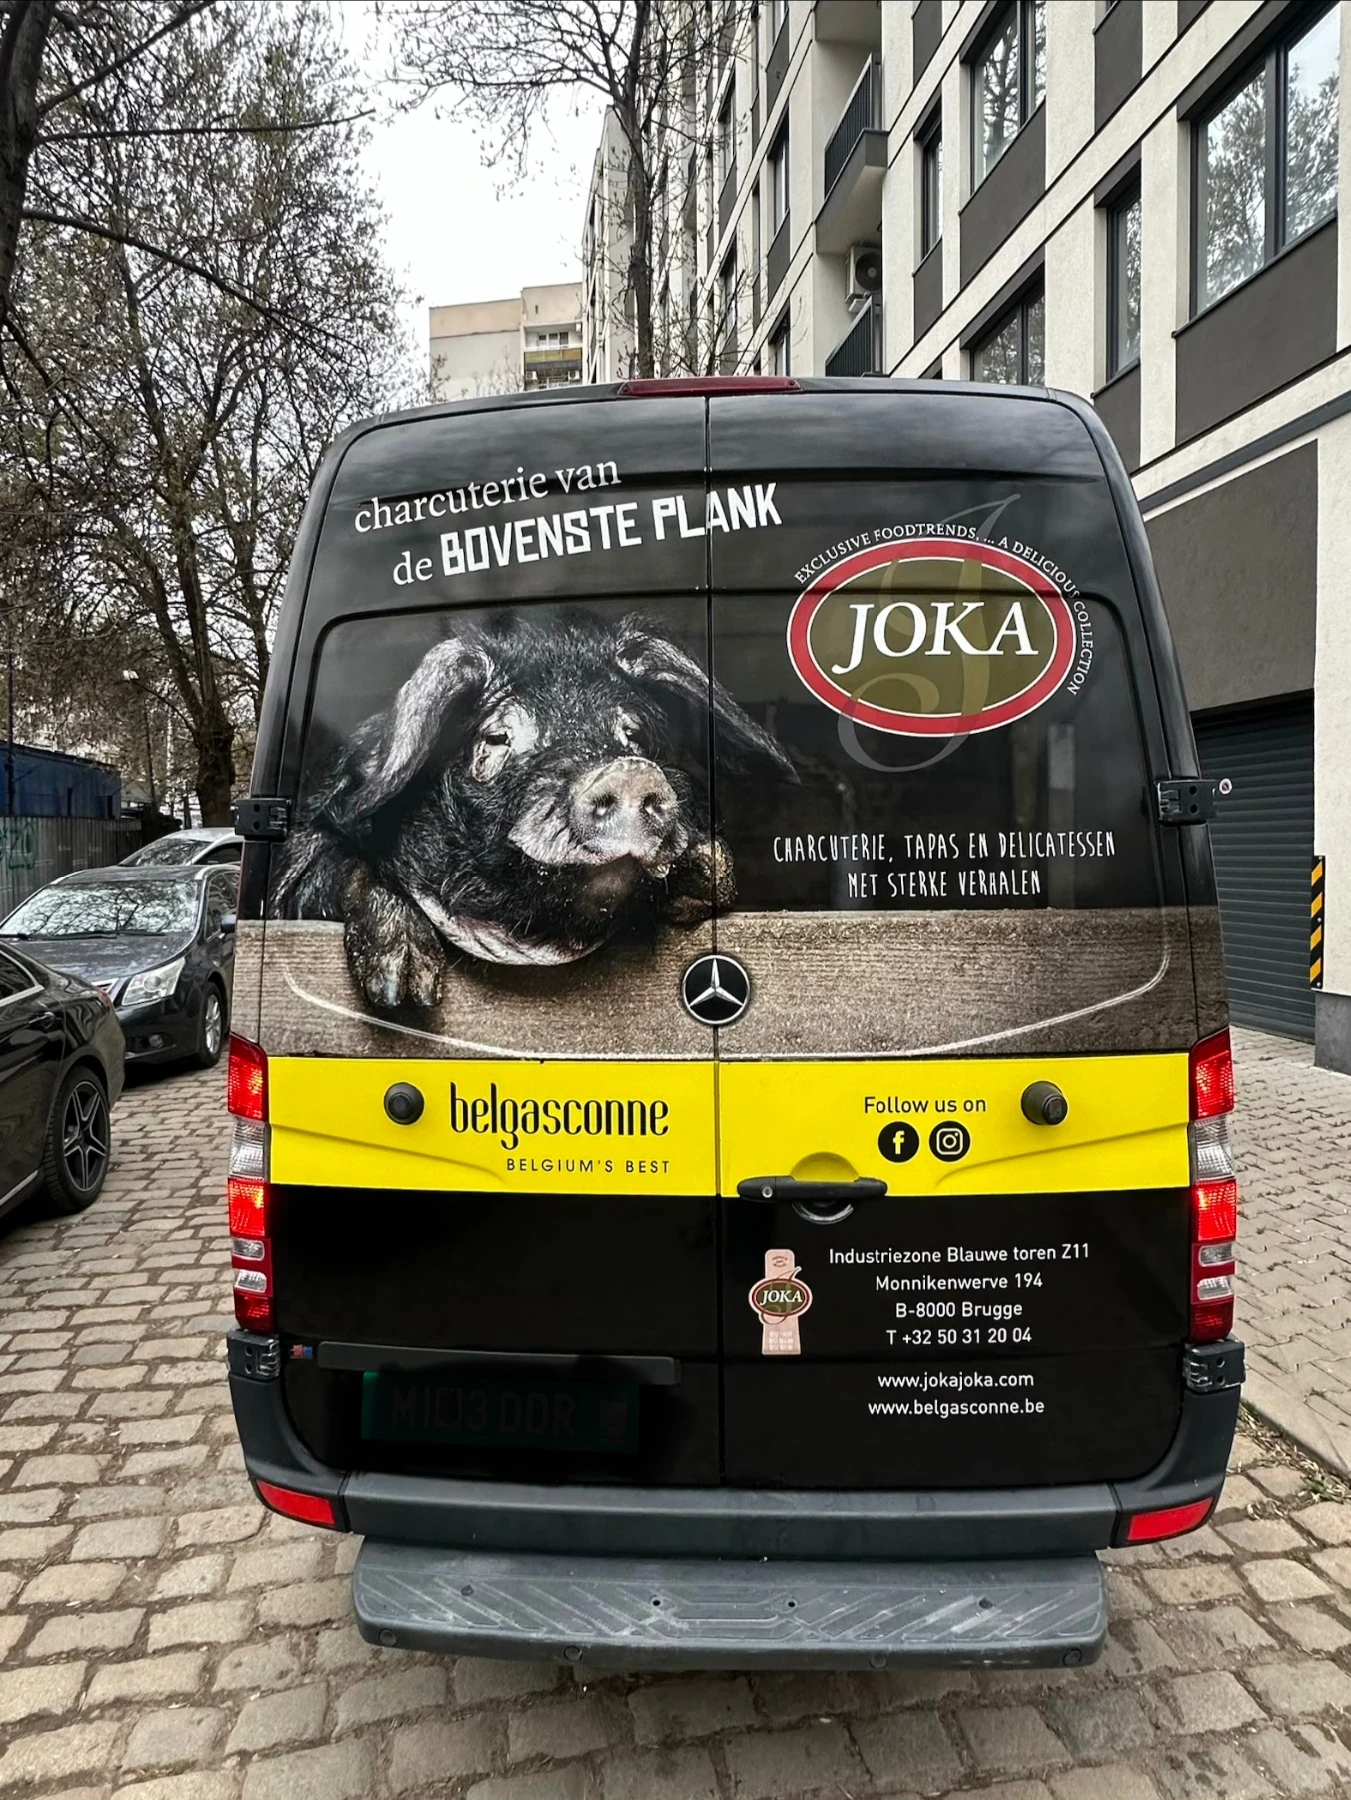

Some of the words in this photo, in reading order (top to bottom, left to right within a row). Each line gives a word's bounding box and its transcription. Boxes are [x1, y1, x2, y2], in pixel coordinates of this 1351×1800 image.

[354, 467, 548, 533] charcuterie
[555, 461, 622, 494] van
[392, 551, 434, 586] de
[441, 502, 642, 577] BOVENSTE
[652, 482, 782, 541] PLANK
[794, 532, 871, 584] EXCLUSIVE
[998, 536, 1008, 549] A
[1067, 601, 1094, 696] COLLECTION
[831, 601, 1039, 675] JOKA
[773, 832, 893, 863] CHARCUTERIE,
[904, 833, 960, 860] TAPAS
[968, 832, 989, 859] EN
[998, 830, 1115, 858] DELICATESSEN
[848, 872, 878, 898] MET
[887, 870, 947, 898] STERKE
[958, 869, 1041, 896] VERHALEN
[864, 1096, 929, 1114] Follow
[935, 1100, 957, 1113] us
[963, 1099, 986, 1113] on
[450, 1081, 669, 1151] belgasconne
[507, 1158, 613, 1173] BELGIUM'S
[625, 1160, 670, 1174] BEST
[829, 1247, 942, 1264] Industriezone
[947, 1246, 1008, 1263] Blauwe
[1012, 1246, 1057, 1261] toren
[1061, 1243, 1089, 1259] Z11
[876, 1274, 1009, 1291] Monnikenwerve
[1014, 1272, 1043, 1289] 194
[760, 1290, 803, 1306] JOKA
[895, 1302, 956, 1318] B-8000
[961, 1302, 1023, 1320] Brugge
[885, 1329, 897, 1345] T
[902, 1329, 932, 1345] +32
[937, 1328, 957, 1345] 50
[961, 1328, 981, 1344] 31
[987, 1327, 1007, 1344] 20
[1012, 1327, 1032, 1343] 04
[877, 1371, 1034, 1391] www.jokajoka.com
[868, 1398, 1045, 1419] www.belgasconne.be
